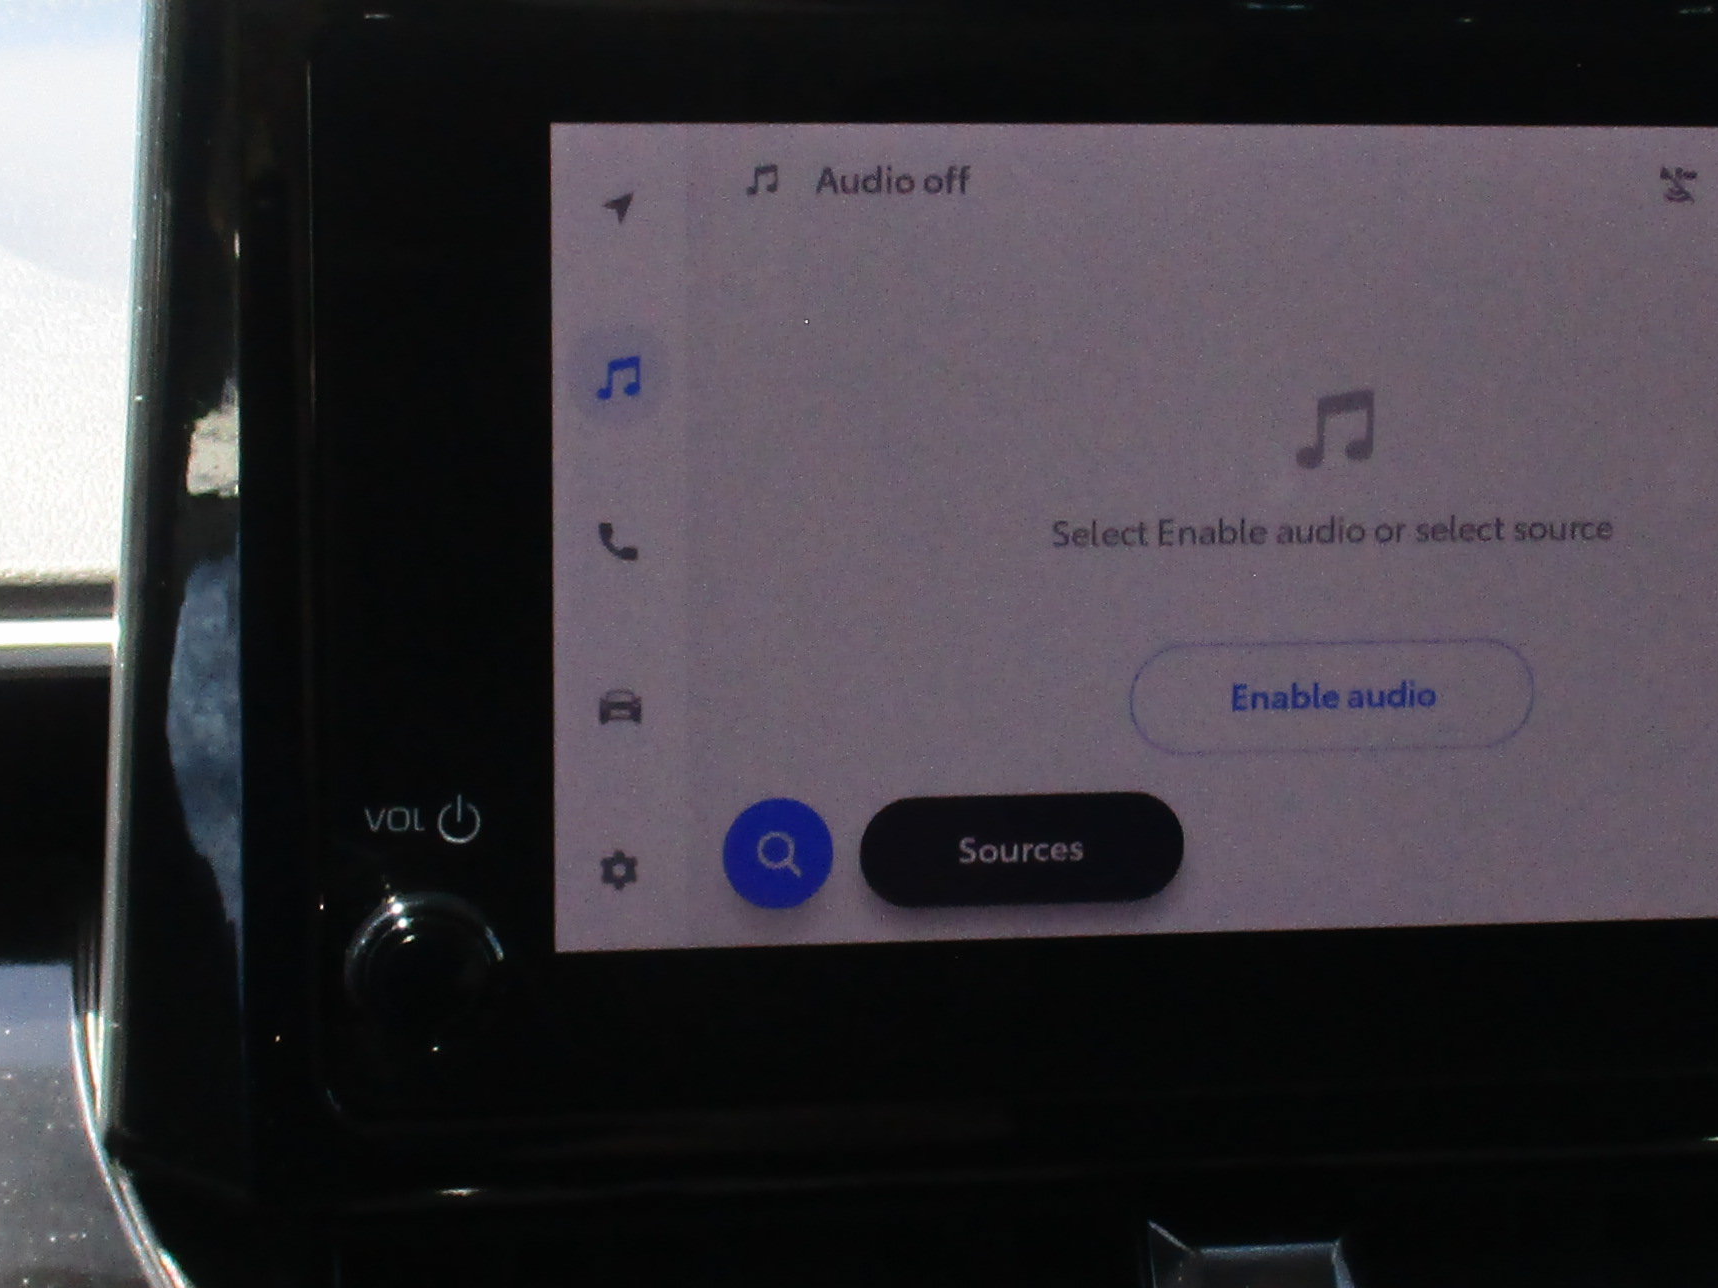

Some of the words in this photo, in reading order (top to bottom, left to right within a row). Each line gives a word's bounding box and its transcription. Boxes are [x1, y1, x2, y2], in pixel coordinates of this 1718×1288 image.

[815, 165, 913, 195] Audio
[923, 165, 971, 195] off
[1052, 519, 1149, 549] Select
[1157, 517, 1268, 547] Enable
[1276, 515, 1367, 545] audio
[1373, 522, 1407, 545] or
[1415, 514, 1505, 543] select
[1513, 520, 1614, 543] source
[1231, 681, 1340, 712] Enable
[1347, 680, 1437, 709] audio
[364, 806, 426, 832] VOL
[959, 836, 1084, 864] Sources
